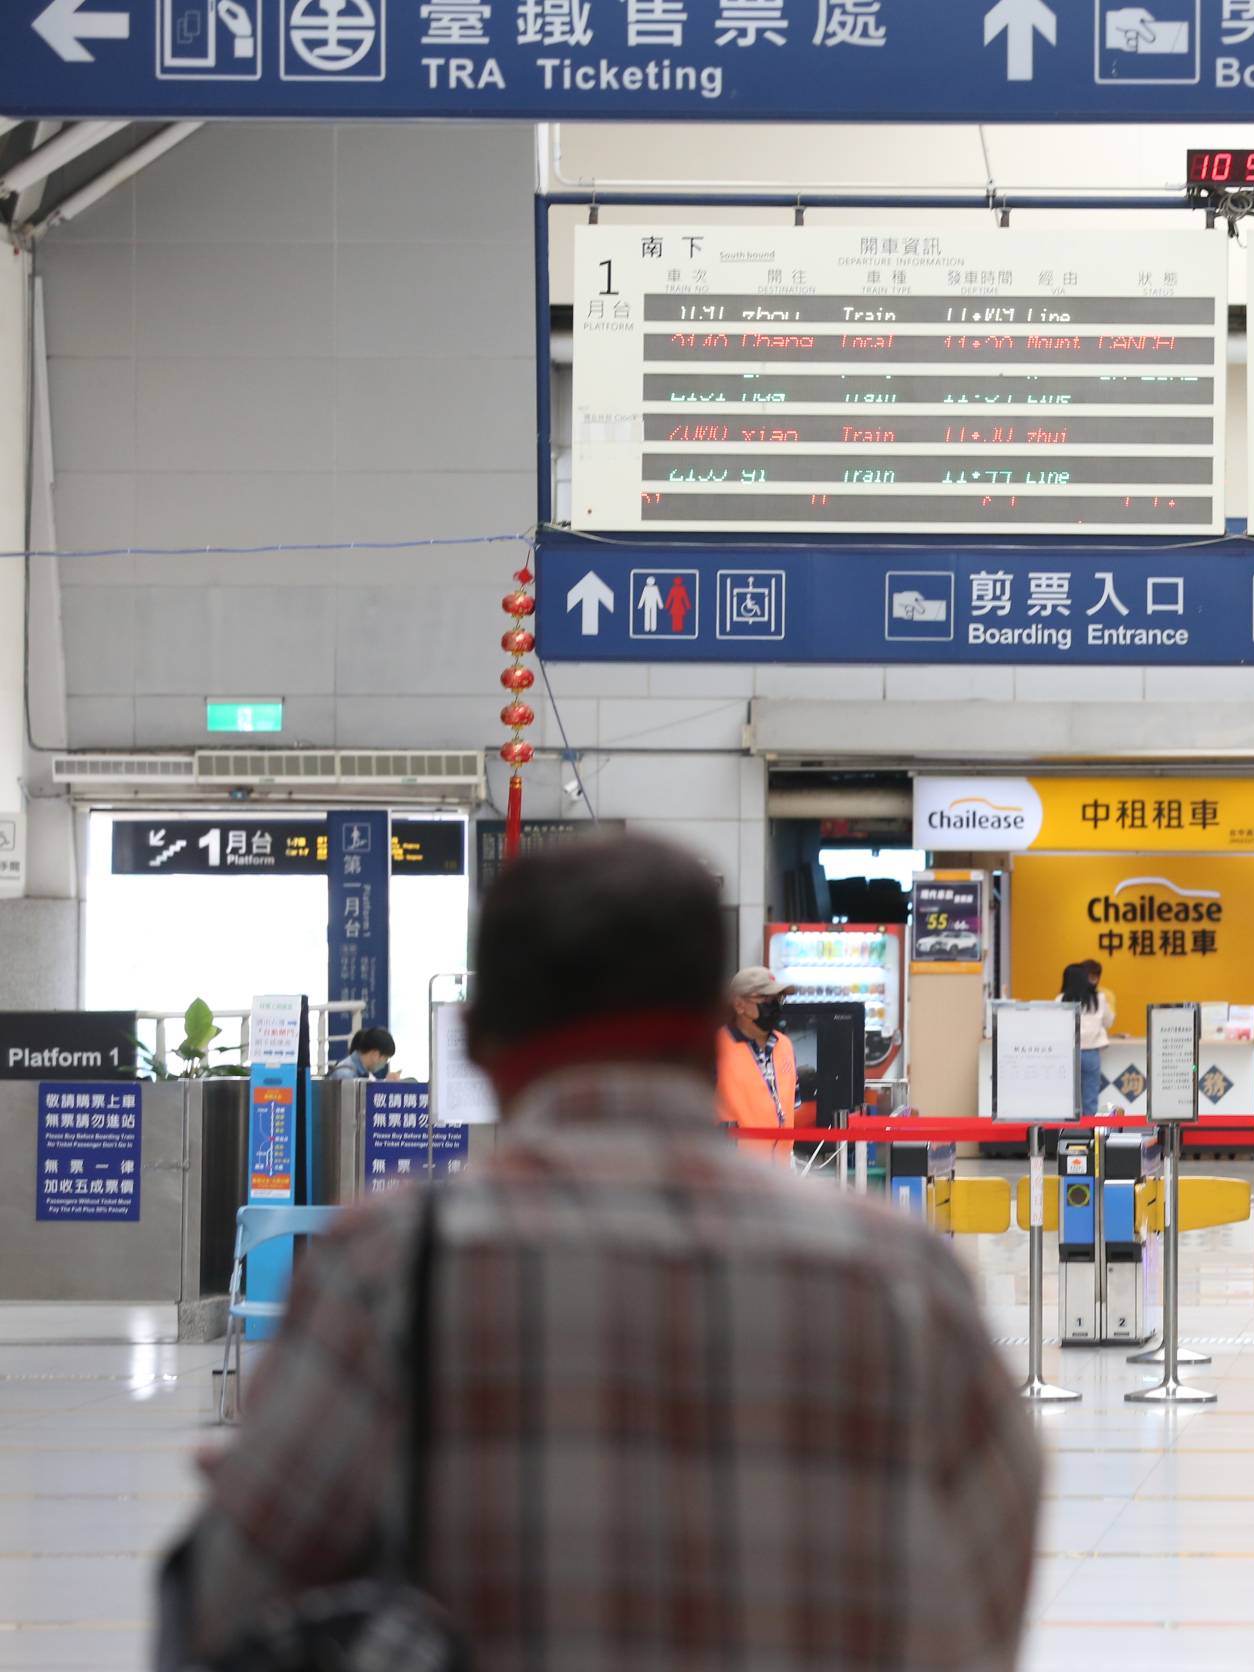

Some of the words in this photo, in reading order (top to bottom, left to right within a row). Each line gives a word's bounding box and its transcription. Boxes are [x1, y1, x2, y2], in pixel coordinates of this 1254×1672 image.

[421, 58, 506, 90] TRA
[536, 58, 724, 99] Ticketing
[1199, 153, 1232, 181] 10
[641, 236, 705, 260] 南下
[859, 236, 942, 256] 開車資訊
[598, 259, 619, 295] 1
[667, 269, 708, 283] 車次
[767, 269, 807, 284] 開往
[867, 270, 907, 285] 車種
[588, 301, 631, 318] 月台
[583, 322, 634, 332] PLATFORM
[968, 570, 1185, 617] 剪票入口
[967, 623, 1072, 650] Boarding
[1087, 624, 1189, 646] Entrance
[927, 810, 1025, 830] Chailease
[1081, 798, 1220, 830] 中租租車
[198, 828, 221, 867] 1
[226, 830, 272, 855] 月台
[226, 854, 276, 866] Platform
[343, 855, 361, 938] 第一月台
[1086, 896, 1223, 923] Chailease
[1098, 928, 1218, 957] 中租租車
[8, 1047, 102, 1068] Platform
[109, 1047, 120, 1067] 1
[45, 1093, 136, 1109] 敬請購票上車
[45, 1113, 136, 1129] 無票請勿進站
[44, 1159, 135, 1174] 無票一律
